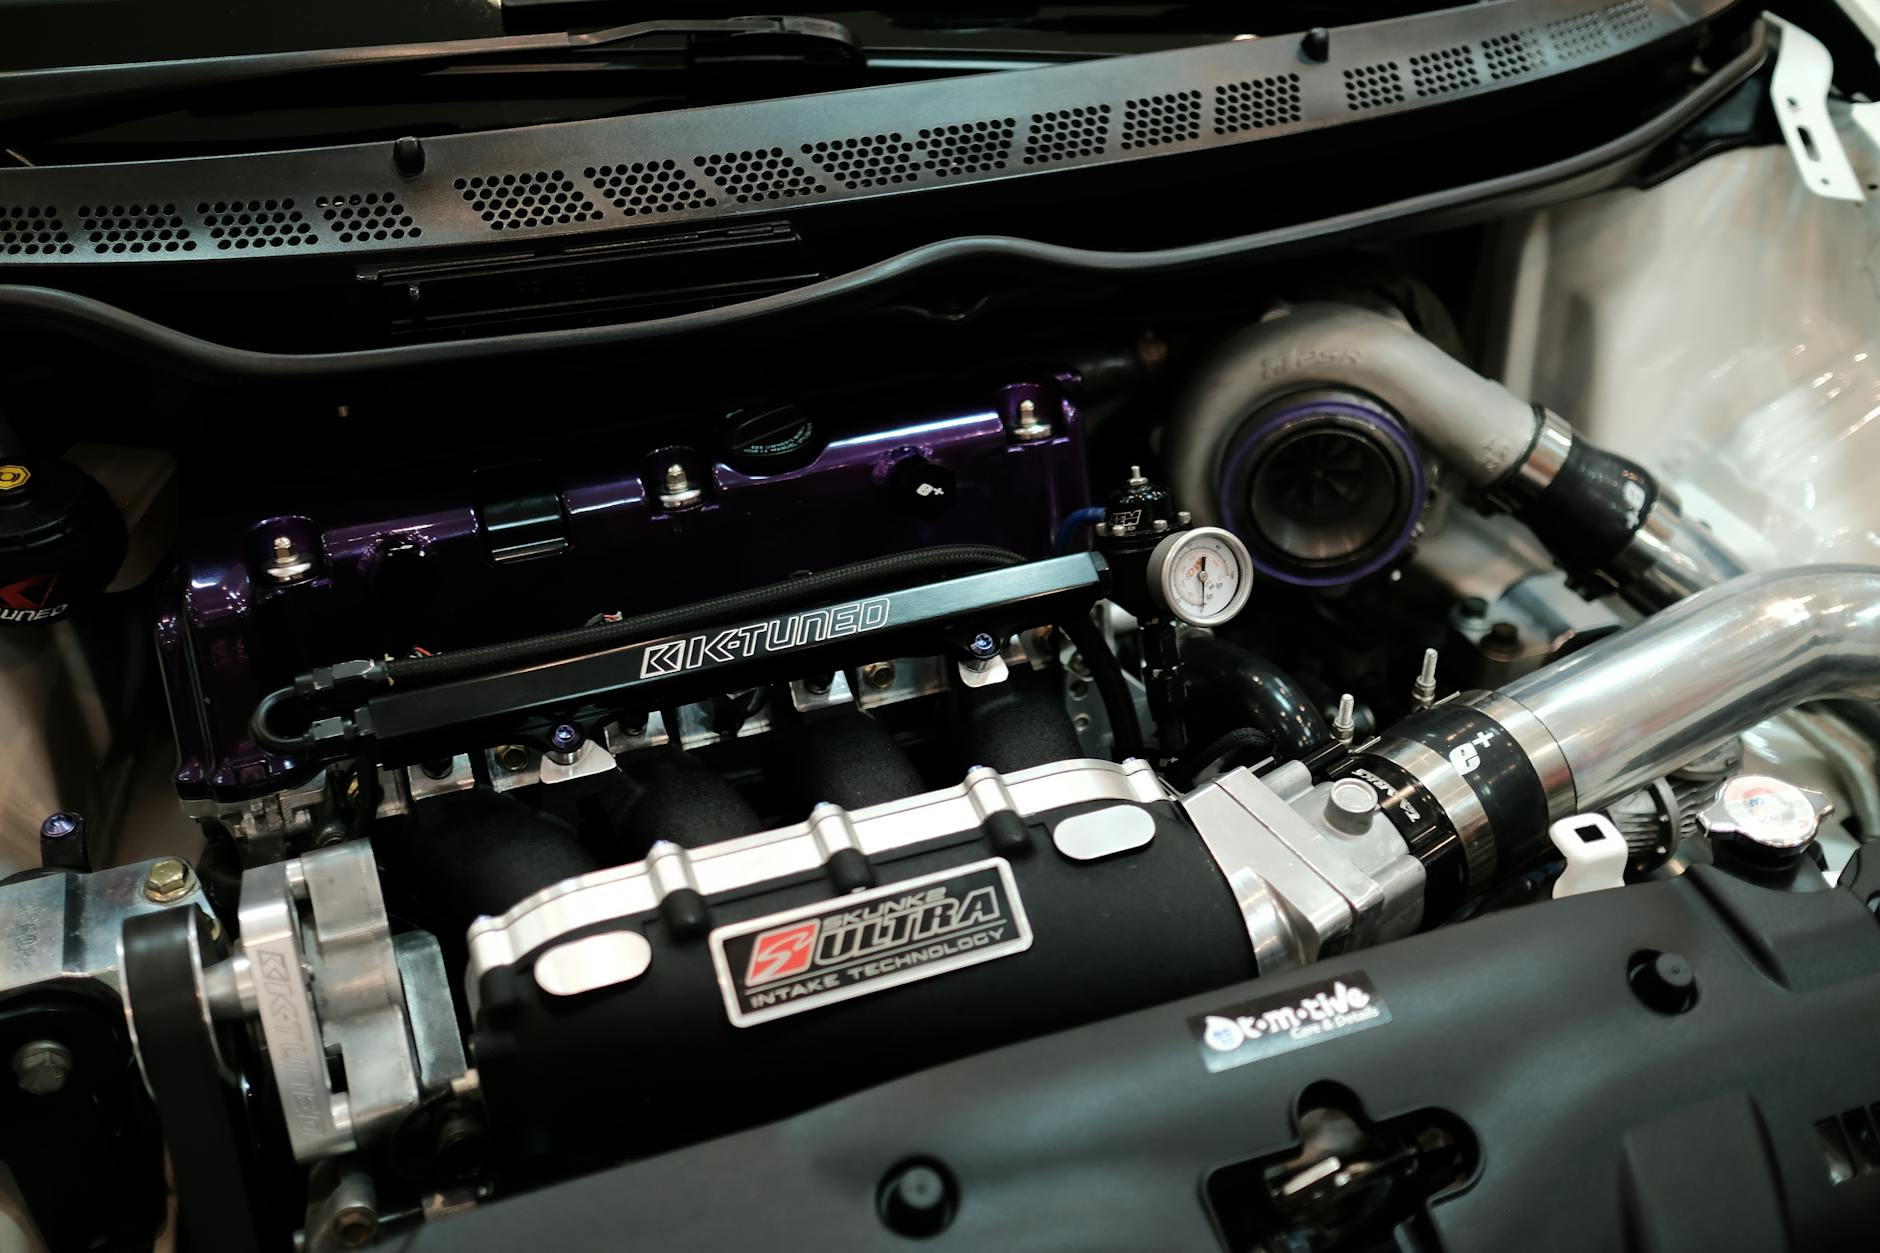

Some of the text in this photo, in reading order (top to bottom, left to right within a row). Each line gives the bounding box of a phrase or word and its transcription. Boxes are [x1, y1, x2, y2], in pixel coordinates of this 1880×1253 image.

[0, 603, 69, 622] UNED
[686, 597, 891, 670] K-TUNED
[813, 886, 1001, 967] ULTRA
[750, 927, 1005, 1009] INTAKE TECHNOLOGY
